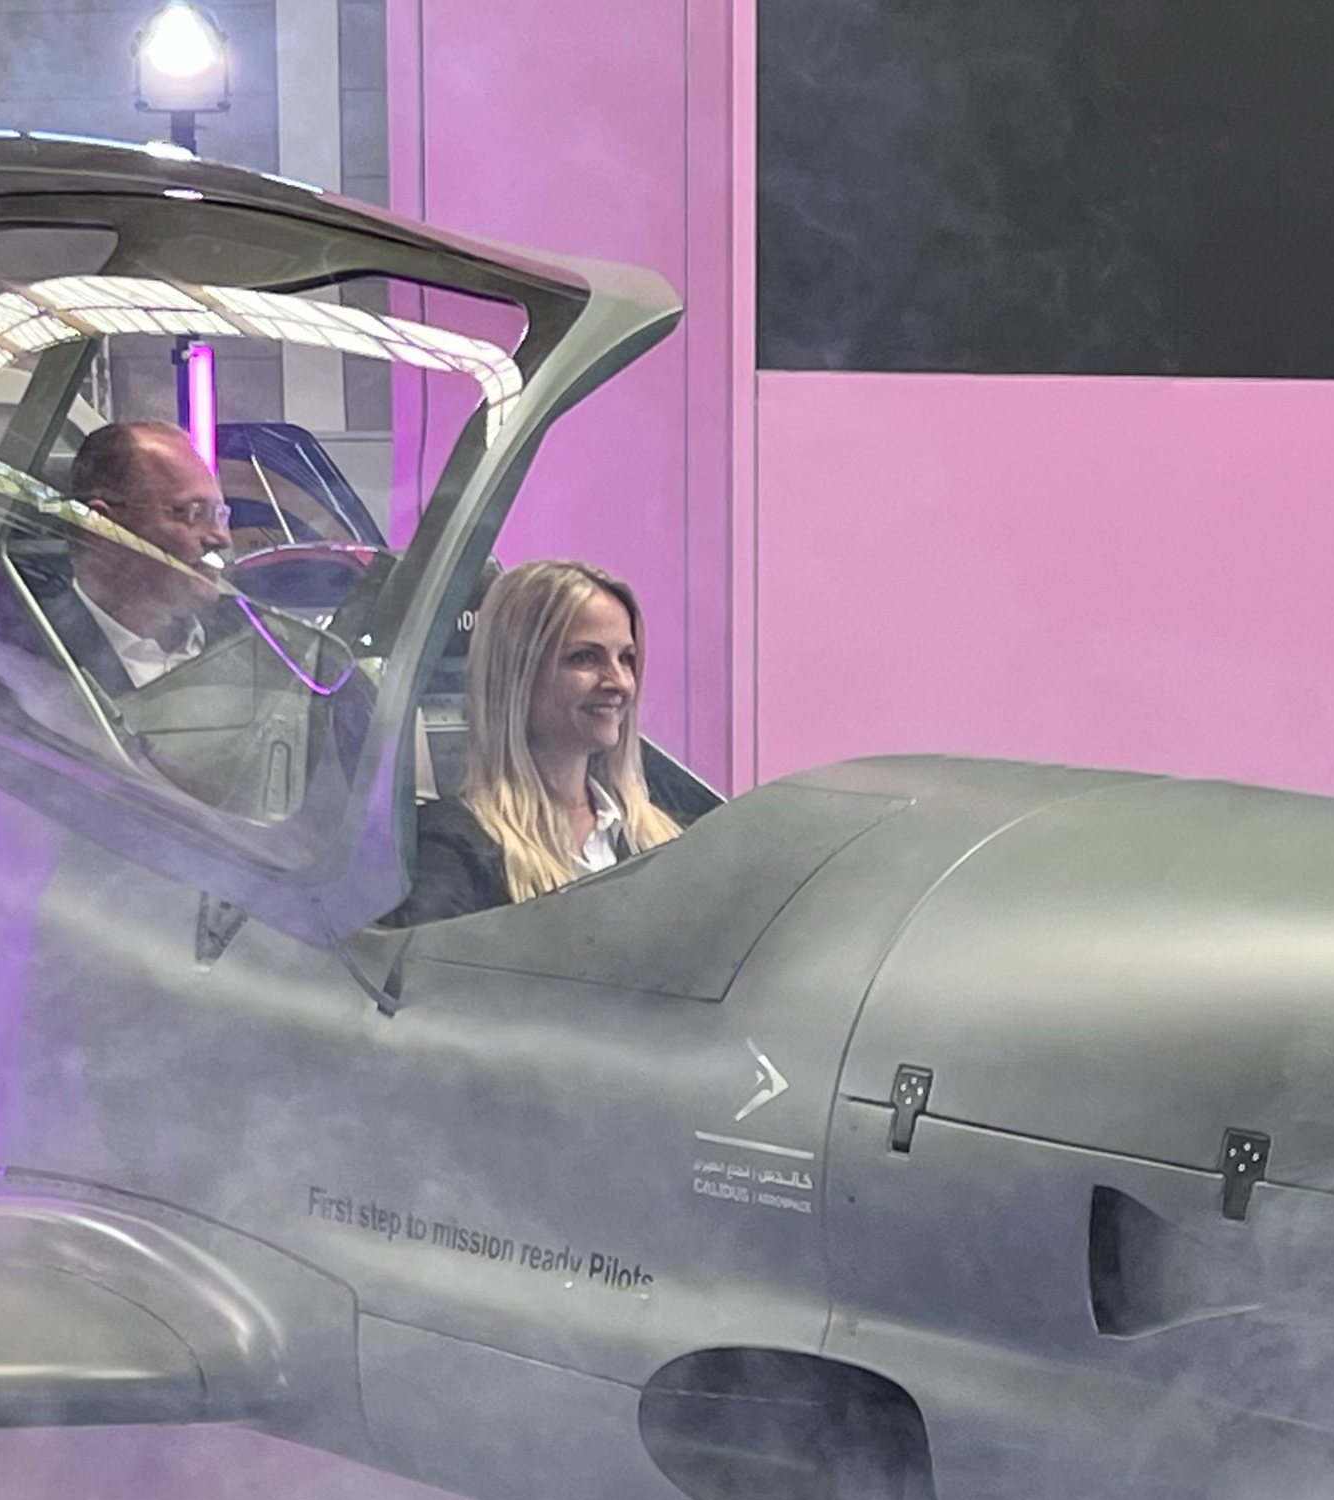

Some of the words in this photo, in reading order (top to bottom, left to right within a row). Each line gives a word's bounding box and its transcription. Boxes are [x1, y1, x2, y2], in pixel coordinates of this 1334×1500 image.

[307, 1186, 353, 1225] First
[359, 1202, 401, 1242] step
[407, 1211, 427, 1241] to
[432, 1219, 515, 1263] mission
[589, 1251, 655, 1290] Pilots
